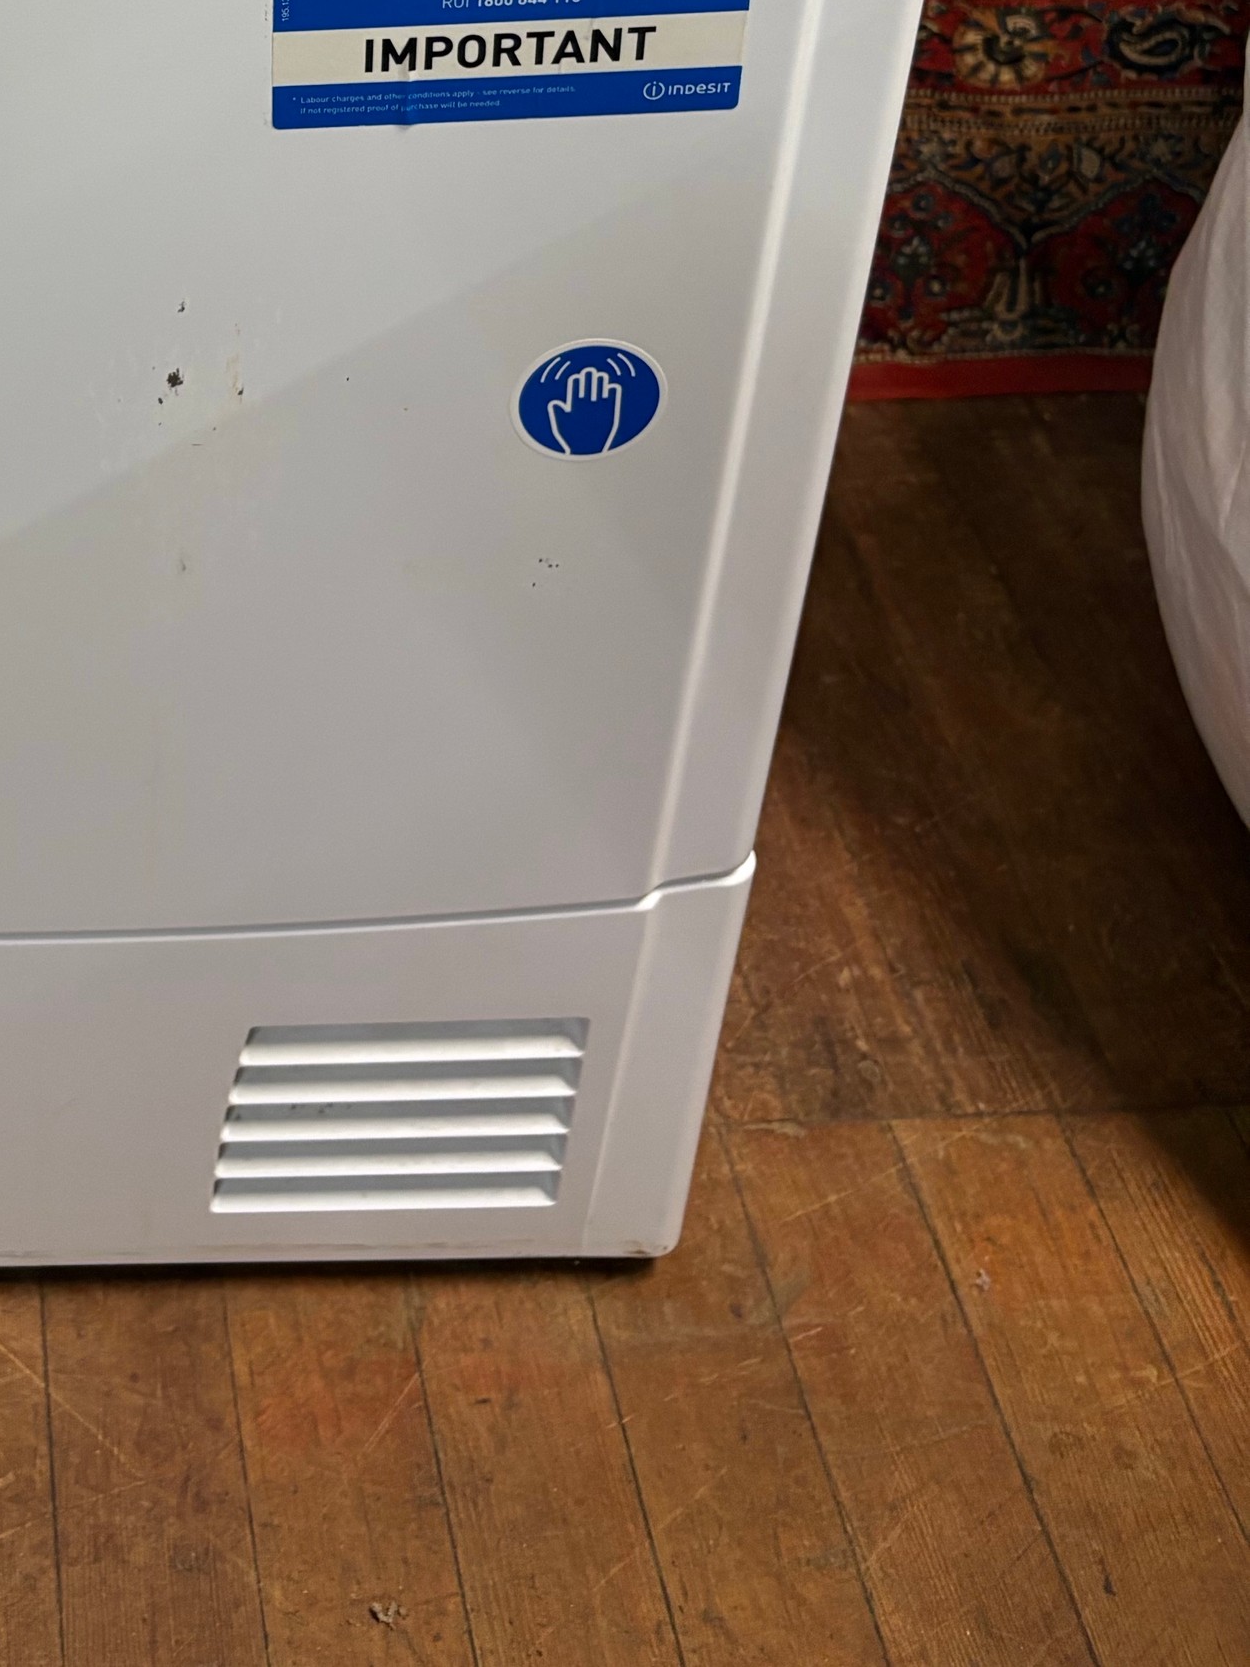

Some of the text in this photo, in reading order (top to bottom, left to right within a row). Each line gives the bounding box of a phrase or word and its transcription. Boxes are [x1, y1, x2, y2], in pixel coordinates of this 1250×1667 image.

[364, 25, 657, 73] IMPORTANT
[300, 96, 329, 105] Labour
[332, 94, 364, 105] charges
[366, 93, 382, 101] and
[408, 89, 450, 100] conditions
[452, 88, 475, 100] apply
[500, 88, 531, 96] reverse
[533, 86, 544, 94] for
[308, 106, 321, 114] not
[323, 103, 365, 115] registered
[367, 103, 389, 113] proof
[390, 103, 399, 111] of
